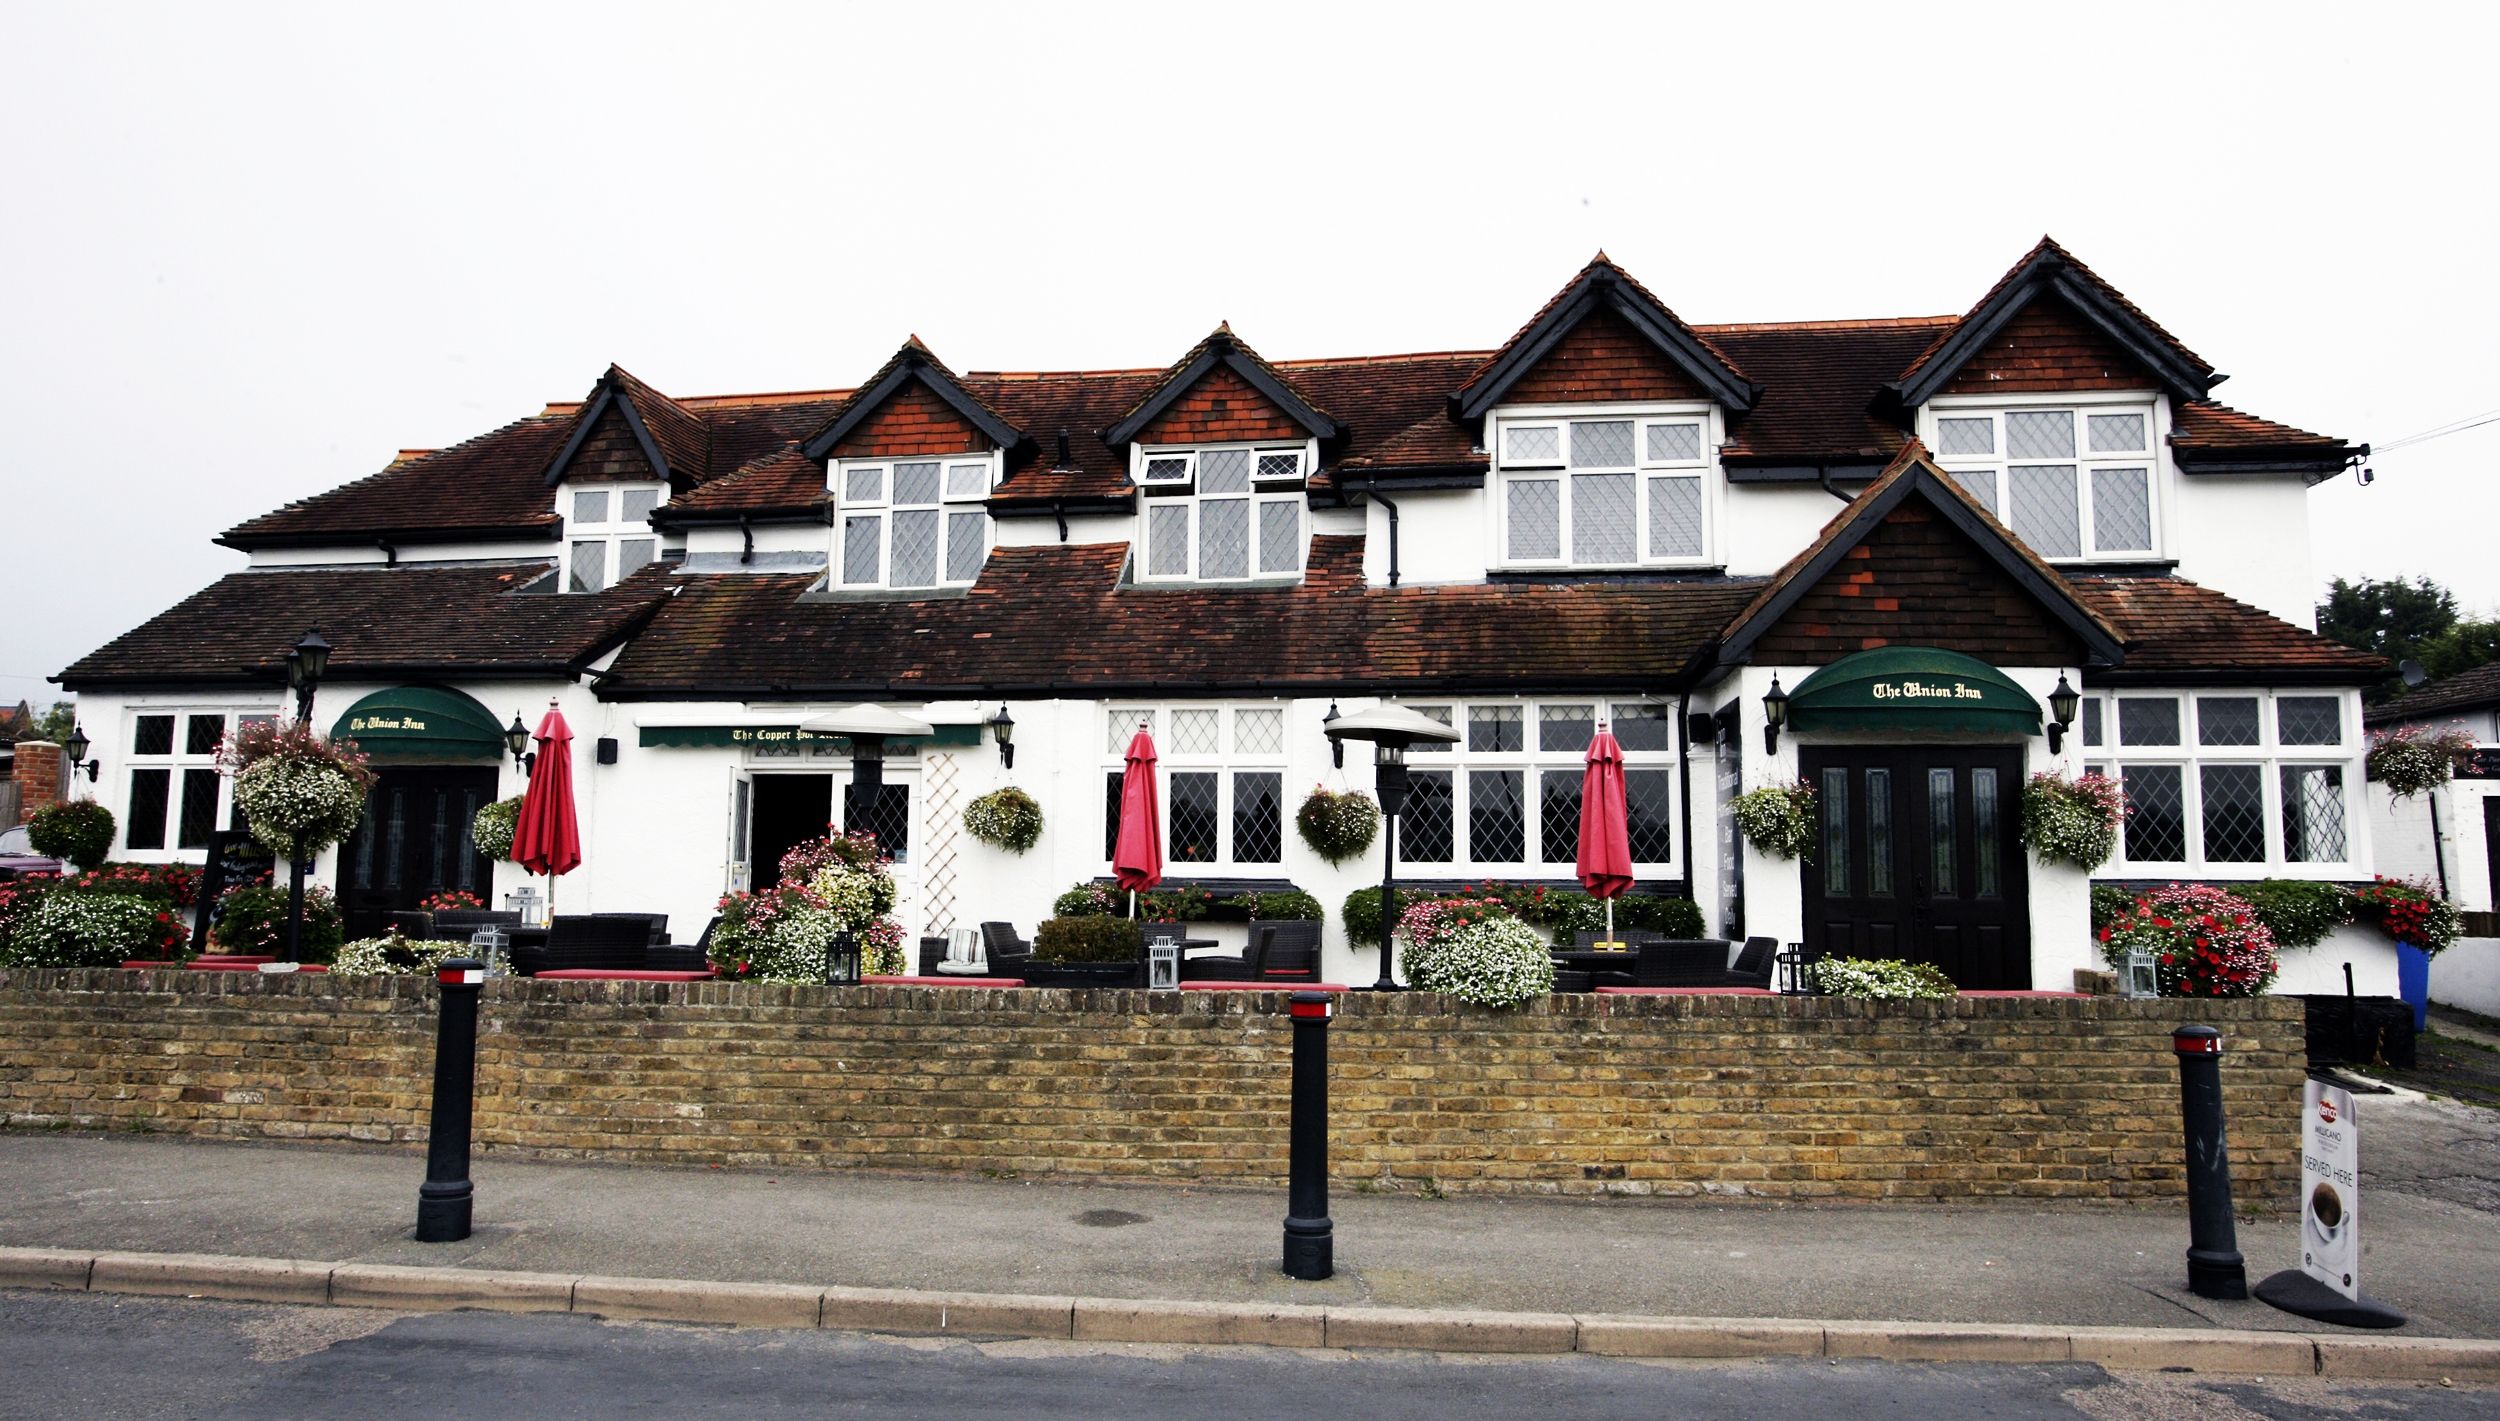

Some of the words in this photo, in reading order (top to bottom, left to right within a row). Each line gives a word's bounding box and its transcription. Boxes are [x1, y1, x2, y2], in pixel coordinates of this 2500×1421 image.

[1873, 683, 1901, 700] The
[1903, 682, 1952, 698] Union
[1954, 683, 1982, 699] Inn
[350, 718, 365, 730] The
[367, 717, 399, 729] Union
[401, 717, 425, 730] Inn
[732, 730, 753, 741] The
[757, 729, 792, 740] Copper
[2317, 1103, 2337, 1118] Kenco
[2304, 1155, 2332, 1178] SERVED
[2333, 1166, 2353, 1188] HERE
